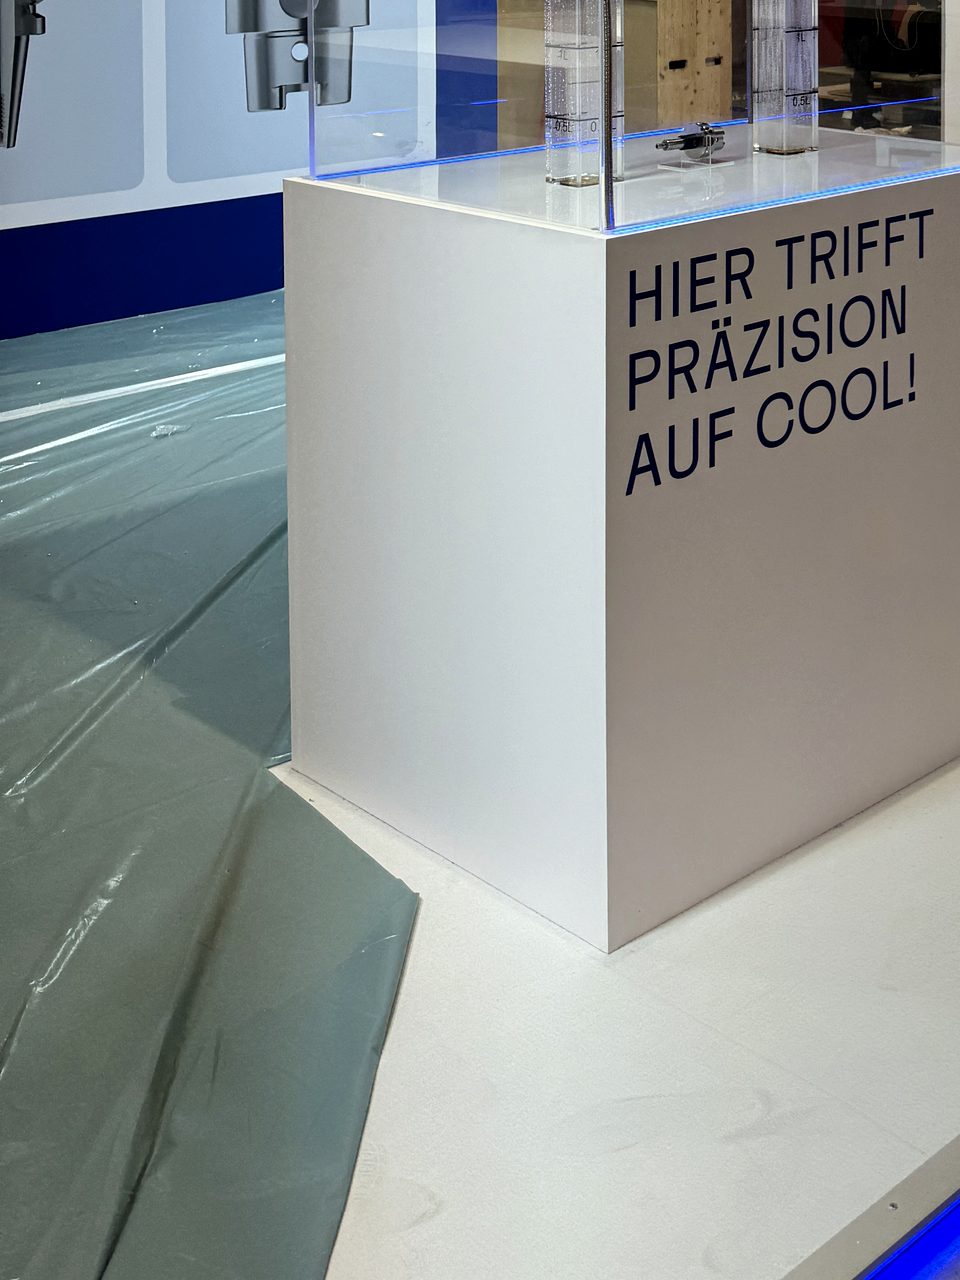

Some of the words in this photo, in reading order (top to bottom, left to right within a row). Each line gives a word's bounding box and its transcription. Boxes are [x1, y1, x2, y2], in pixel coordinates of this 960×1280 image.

[629, 246, 755, 328] HIER
[775, 208, 935, 290] TRIFFT
[629, 285, 906, 412] PRÄZISION
[625, 406, 736, 496] AUF
[756, 352, 916, 449] COOL!
